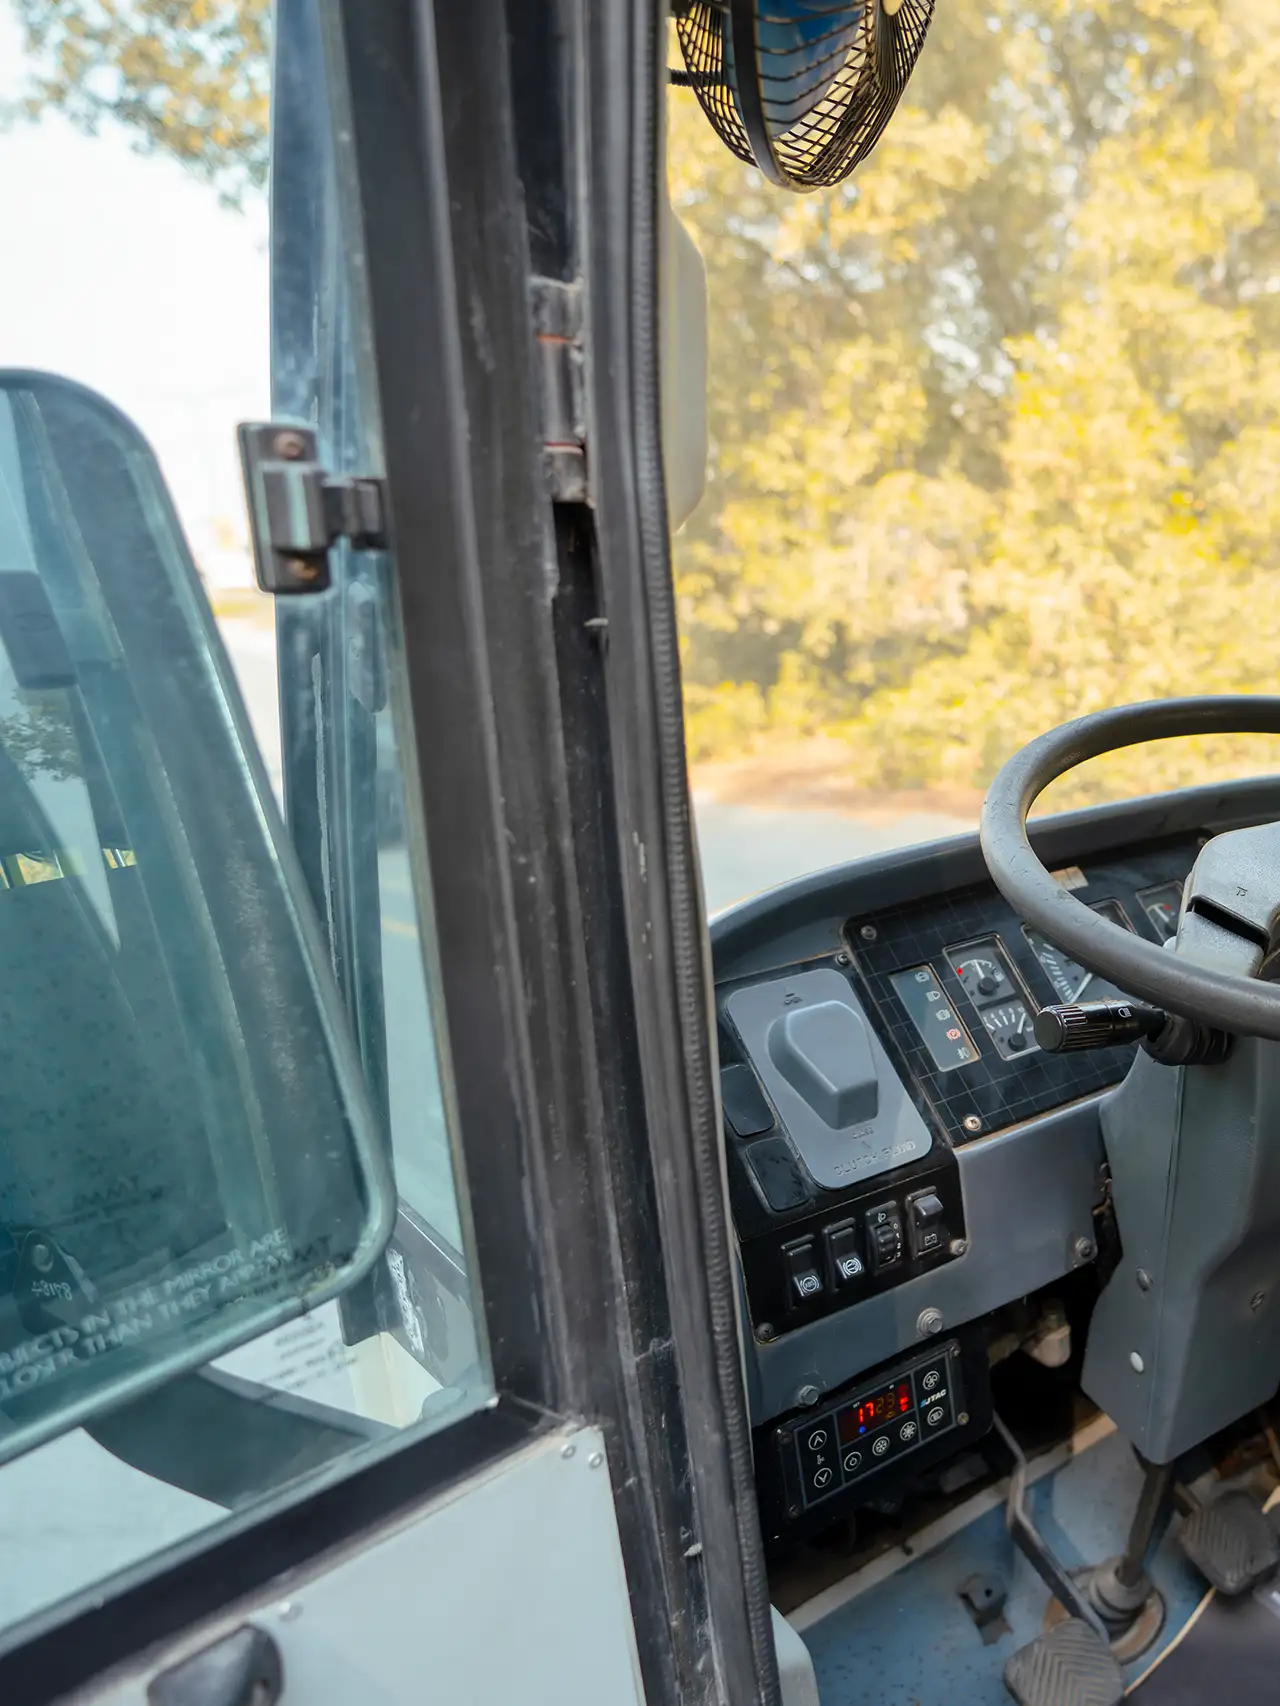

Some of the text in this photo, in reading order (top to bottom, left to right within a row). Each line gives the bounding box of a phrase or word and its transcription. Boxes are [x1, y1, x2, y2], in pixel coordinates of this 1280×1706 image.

[833, 1139, 916, 1177] CLUTCH FLUID
[80, 1310, 110, 1335] IN
[115, 1287, 158, 1318] THE
[162, 1248, 246, 1297] MIRROR
[249, 1227, 288, 1259] ARE
[82, 1311, 153, 1357] THAN
[157, 1286, 211, 1321] THEY
[858, 1401, 875, 1423] 17
